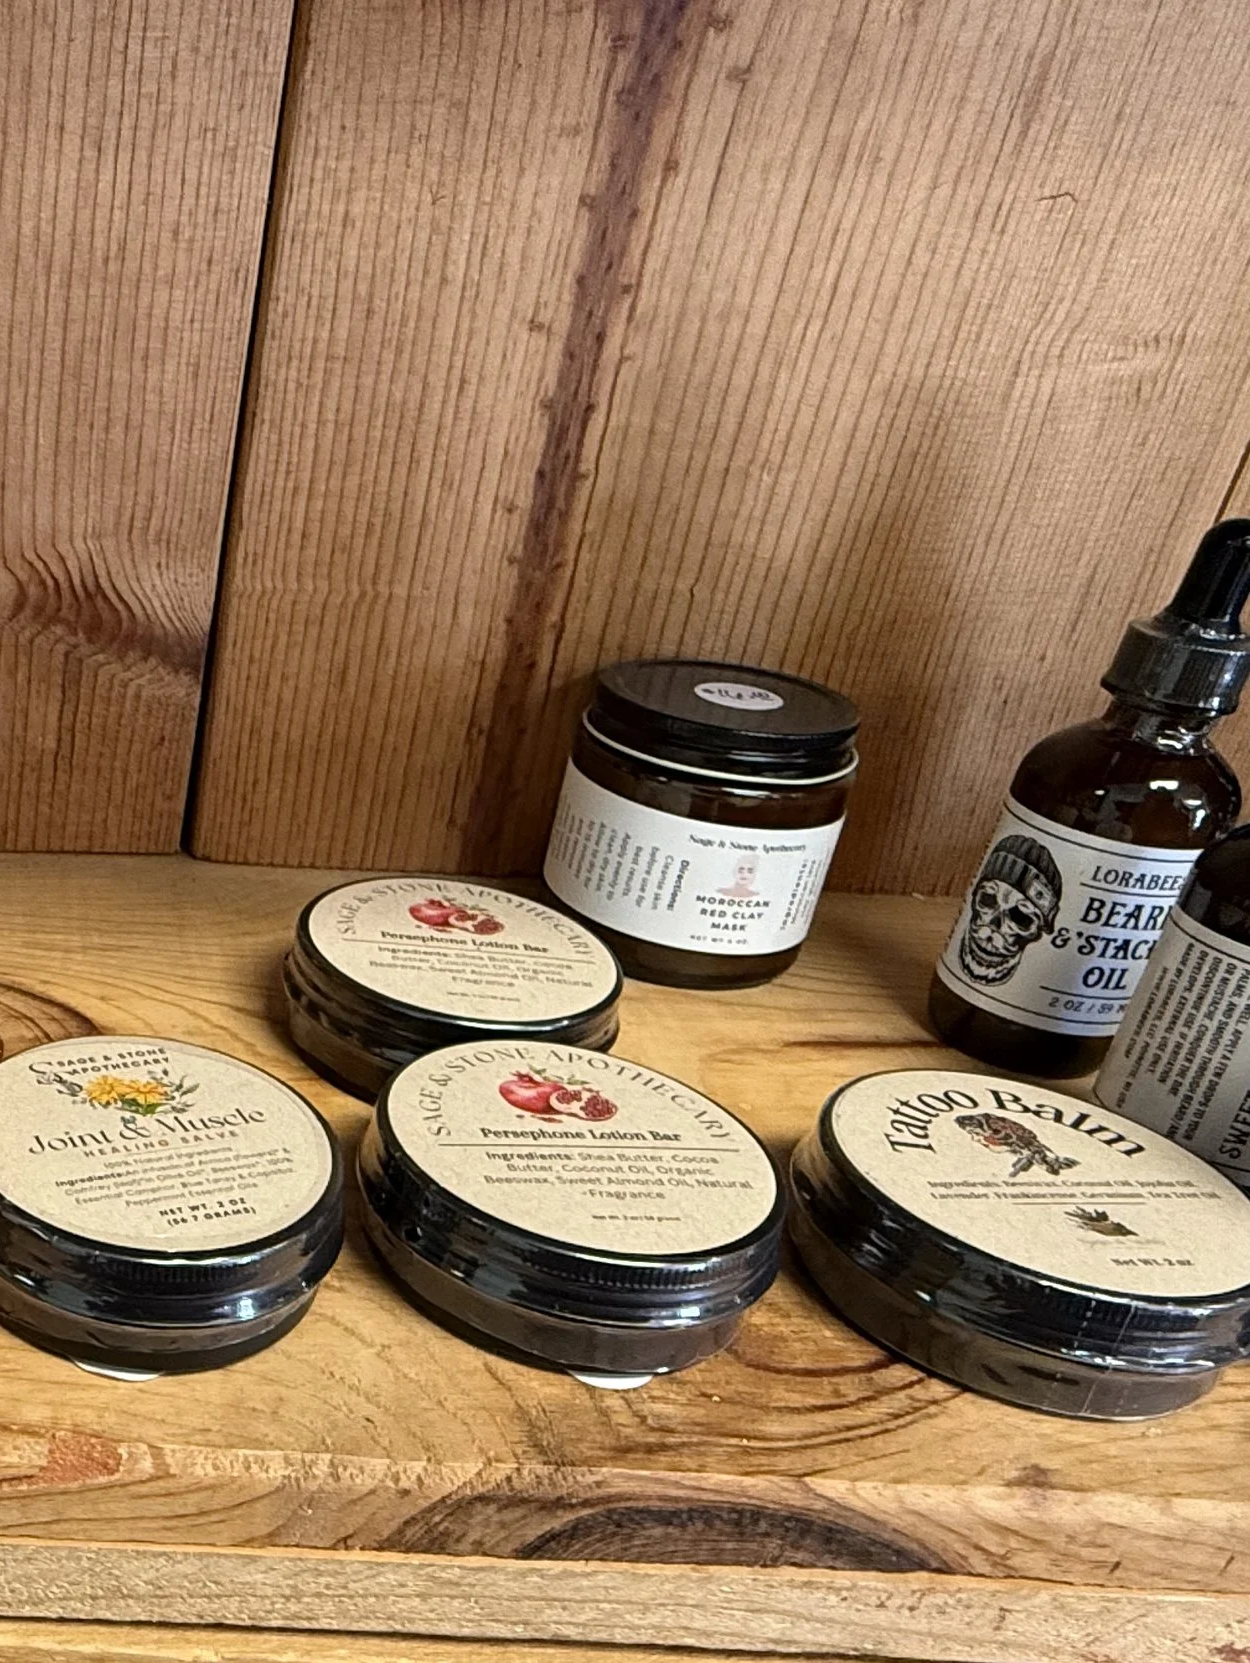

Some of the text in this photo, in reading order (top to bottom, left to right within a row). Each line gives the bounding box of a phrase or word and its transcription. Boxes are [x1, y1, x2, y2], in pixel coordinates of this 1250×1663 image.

[695, 895, 770, 907] MOROCCAN
[336, 901, 360, 935] SAGE
[372, 883, 451, 896] STONE
[464, 887, 591, 954] APOTHECARY
[700, 908, 765, 919] RED CLAY
[710, 922, 748, 931] MASK
[380, 931, 549, 953] Persephone Lotion Bar
[1051, 927, 1071, 949] &
[1082, 966, 1129, 990] OIL
[1224, 962, 1237, 975] OR
[1191, 957, 1222, 1012] DISCONTINUE
[1049, 997, 1060, 1008] 2
[1063, 999, 1083, 1013] OZ
[1098, 1003, 1115, 1014] 59
[1164, 995, 1187, 1033] EXTERNAL
[1222, 1000, 1236, 1019] AND
[1182, 1012, 1195, 1029] USE
[1156, 1035, 1168, 1052] USE
[1183, 1024, 1208, 1064] CONQUER
[1205, 1019, 1228, 1054] SMOOTH
[1223, 1028, 1242, 1054] APPLY
[57, 1048, 167, 1068] SAGE & STONE
[68, 1057, 170, 1075] APOTHECARY
[1157, 1041, 1182, 1083] IRRITATION
[1175, 1064, 1190, 1079] THE
[1187, 1056, 1211, 1093] THROUGH
[1212, 1061, 1227, 1079] FEW
[419, 1047, 731, 1138] SAGE & STONE APOTHECARY
[1198, 1079, 1218, 1107] DROPS
[1192, 1105, 1206, 1119] TO
[29, 1107, 267, 1154] Joint & Muscle
[884, 1088, 1147, 1158] Tattoo Balm
[1182, 1120, 1199, 1140] YOUR
[1218, 1088, 1250, 1159] SWEE
[83, 1129, 239, 1157] HEALING SALVE
[479, 1127, 682, 1143] Persephone Lotion Bar
[486, 1151, 576, 1163] Ingredients:
[578, 1152, 615, 1163] Shea
[671, 1153, 720, 1164] Cocoa
[562, 1164, 625, 1174] Coconut
[628, 1165, 654, 1176] Oil,
[656, 1166, 714, 1177] Organic
[484, 1175, 753, 1190] Beeswax, Sweet Almond Oil, Natural
[159, 1206, 182, 1216] NET
[228, 1197, 246, 1205] OZ
[203, 1207, 255, 1219] GRAMS)
[1110, 1258, 1138, 1267] Net
[1163, 1258, 1176, 1266] 2
